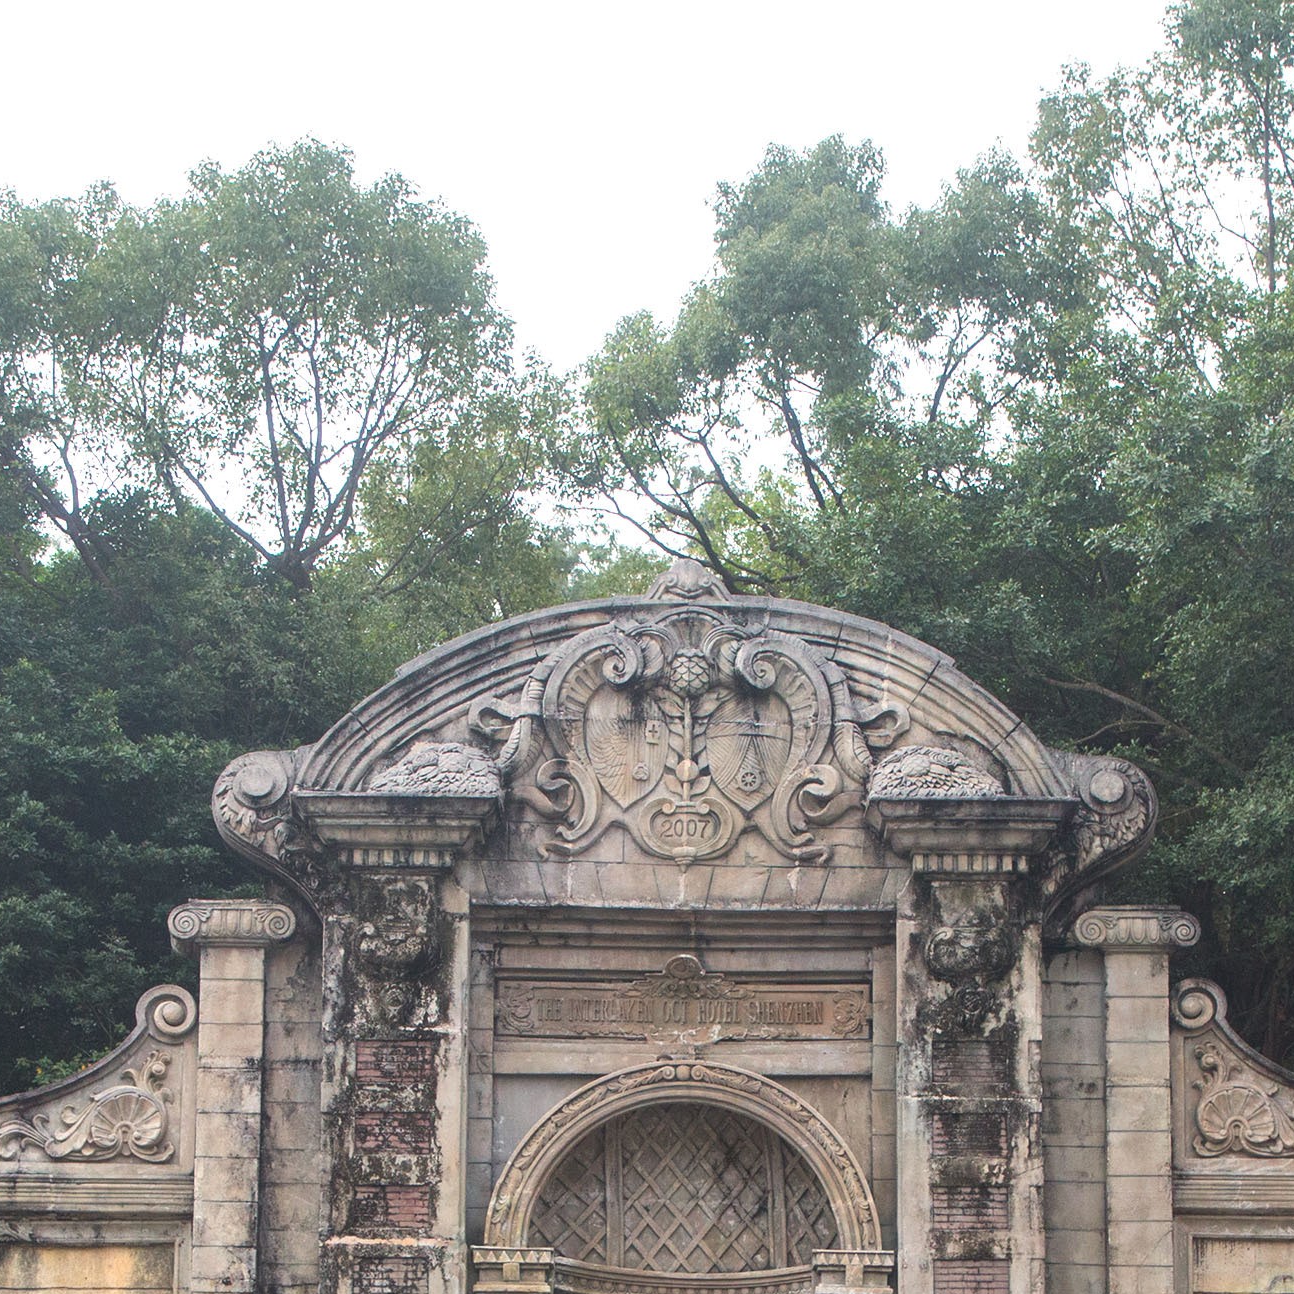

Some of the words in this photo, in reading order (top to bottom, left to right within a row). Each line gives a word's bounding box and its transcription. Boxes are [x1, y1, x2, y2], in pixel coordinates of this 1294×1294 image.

[659, 818, 711, 839] 2007
[536, 998, 563, 1022] THE
[698, 1000, 742, 1024] HOTEL
[749, 1001, 824, 1025] SHENZHEN
